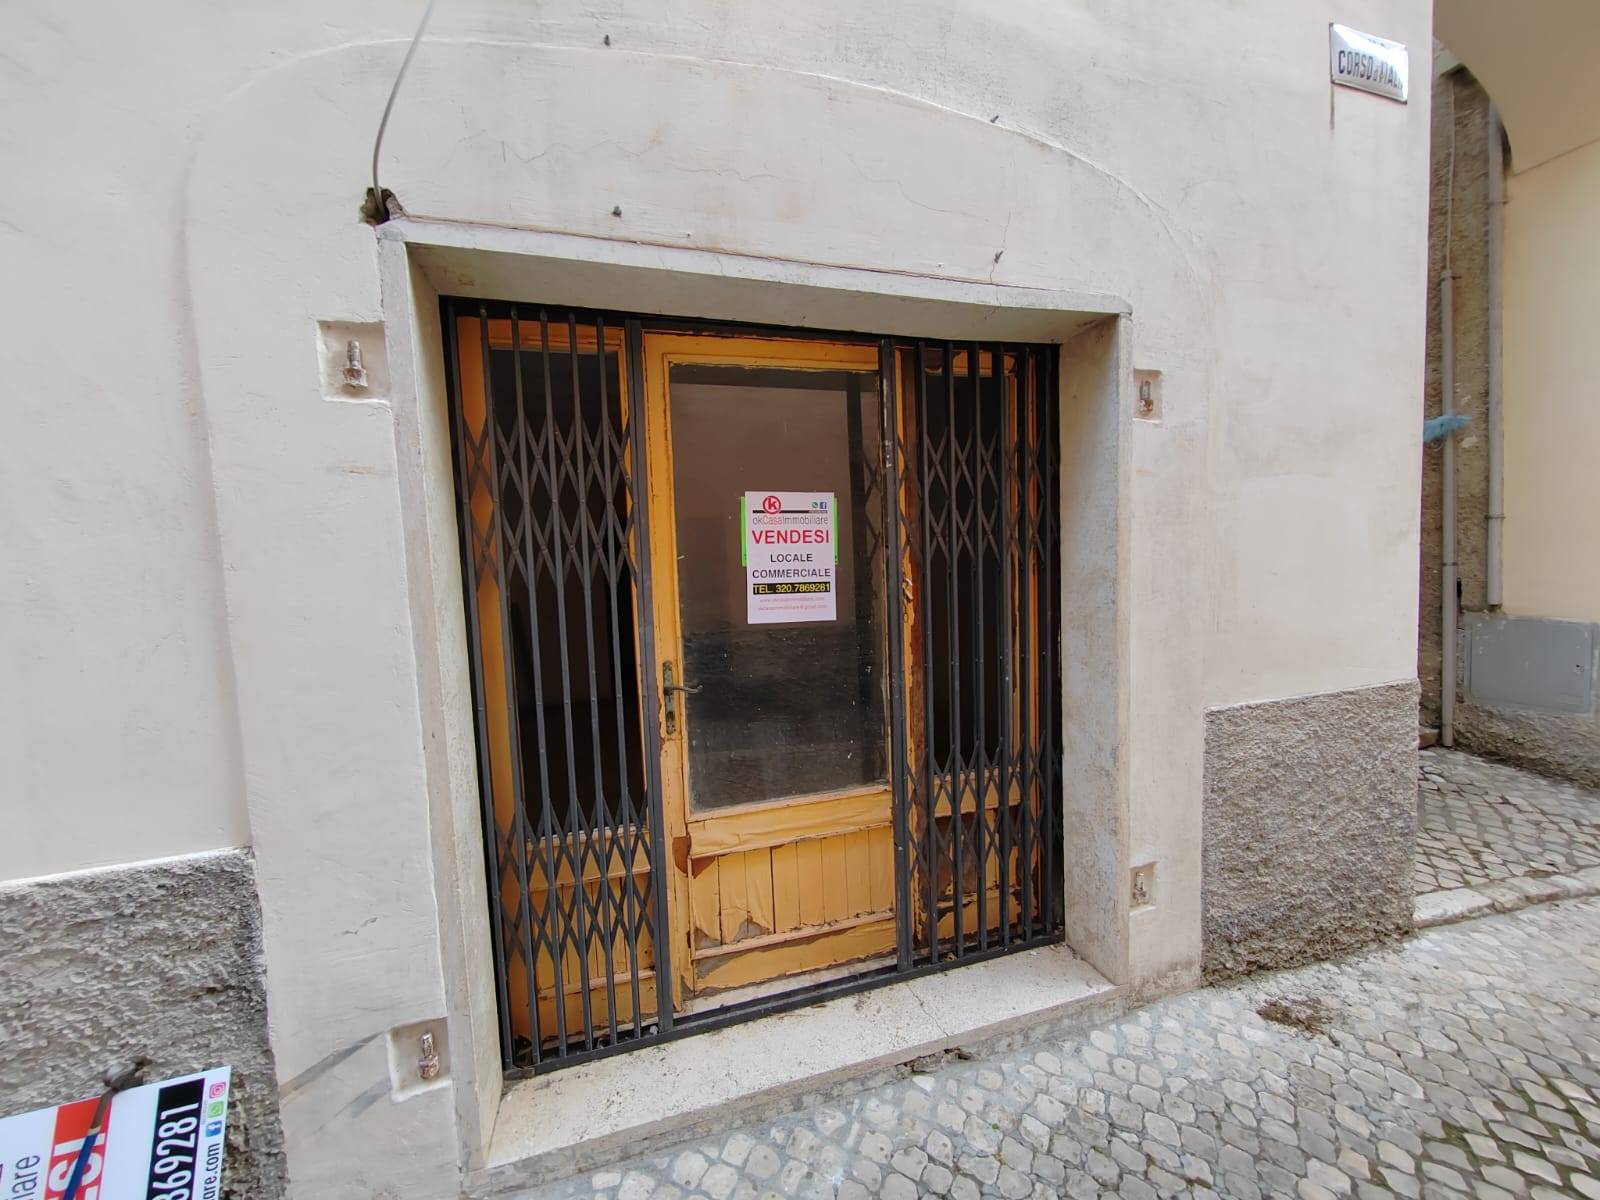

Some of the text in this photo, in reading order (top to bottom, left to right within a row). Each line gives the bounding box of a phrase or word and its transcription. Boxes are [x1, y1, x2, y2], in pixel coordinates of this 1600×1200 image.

[1338, 49, 1374, 81] CORSO
[751, 529, 830, 545] VENDESI
[770, 553, 814, 563] LOCALE
[752, 568, 832, 579] COMMERCIALE
[775, 582, 831, 593] 320.7869281
[202, 1142, 221, 1200] are.com
